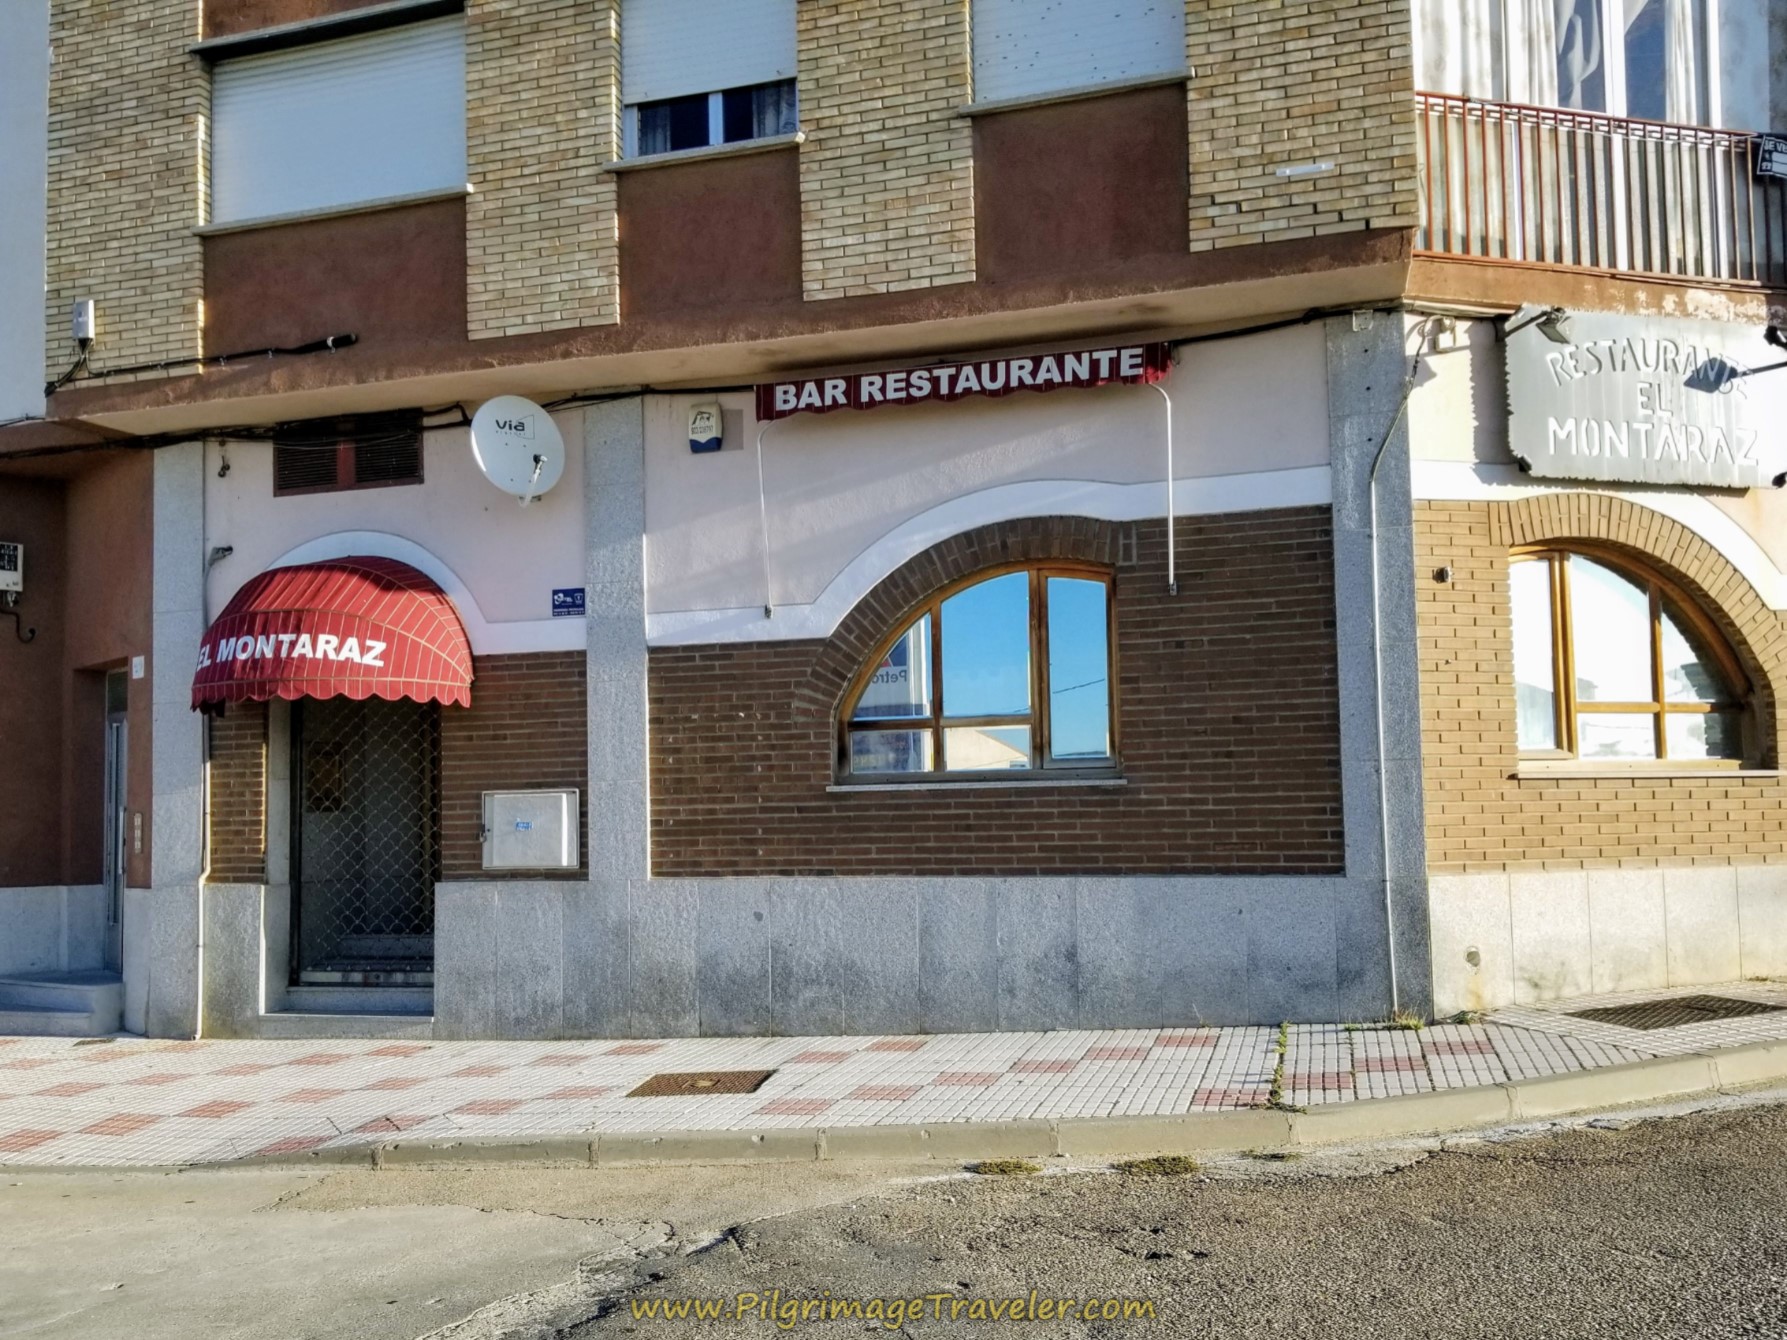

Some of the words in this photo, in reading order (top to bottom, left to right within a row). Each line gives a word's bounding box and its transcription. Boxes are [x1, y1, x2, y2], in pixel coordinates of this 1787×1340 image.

[774, 380, 847, 412] BAR
[860, 348, 1144, 403] RESTAURANTE
[1637, 381, 1674, 418] EL
[1547, 416, 1760, 467] MONTARAZ
[216, 633, 387, 668] MONTARAZ
